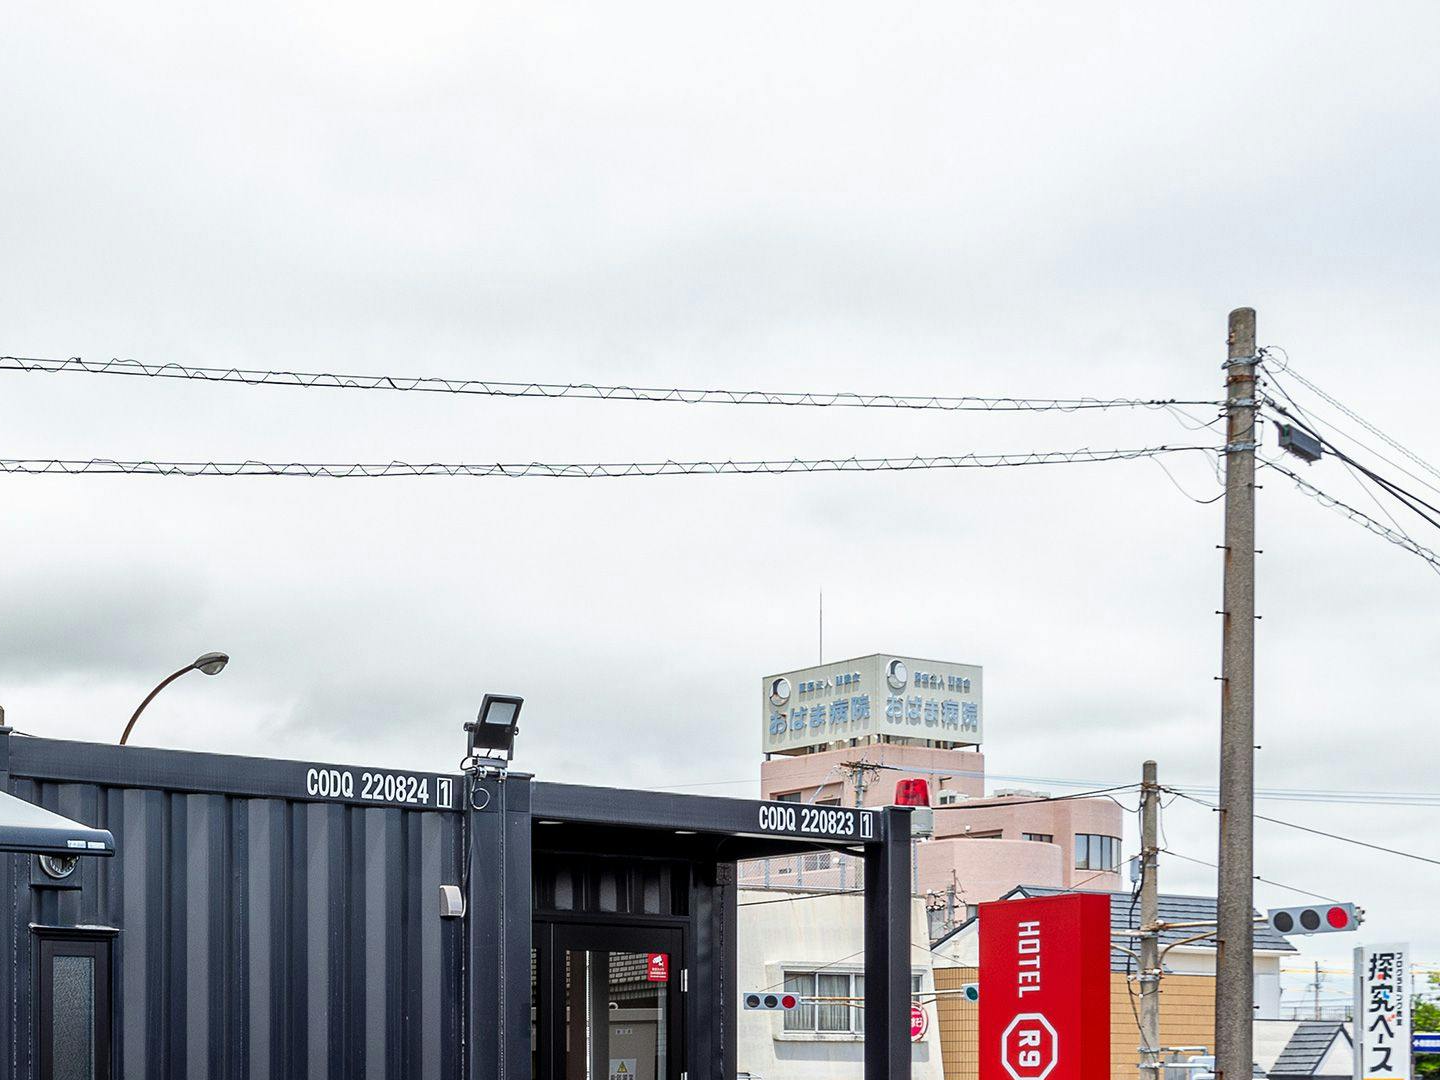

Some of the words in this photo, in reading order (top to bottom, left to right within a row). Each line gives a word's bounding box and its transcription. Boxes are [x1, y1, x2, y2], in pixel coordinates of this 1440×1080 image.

[769, 694, 870, 735] おばま病院
[886, 695, 978, 726] おばま病院
[306, 768, 354, 798] CODQ
[361, 772, 429, 804] 220824
[759, 806, 796, 831] CODQ
[801, 808, 854, 835] 220823
[1018, 920, 1041, 998] HOTEL
[1368, 952, 1395, 1072] 探究ベース
[1018, 1029, 1041, 1068] R9
